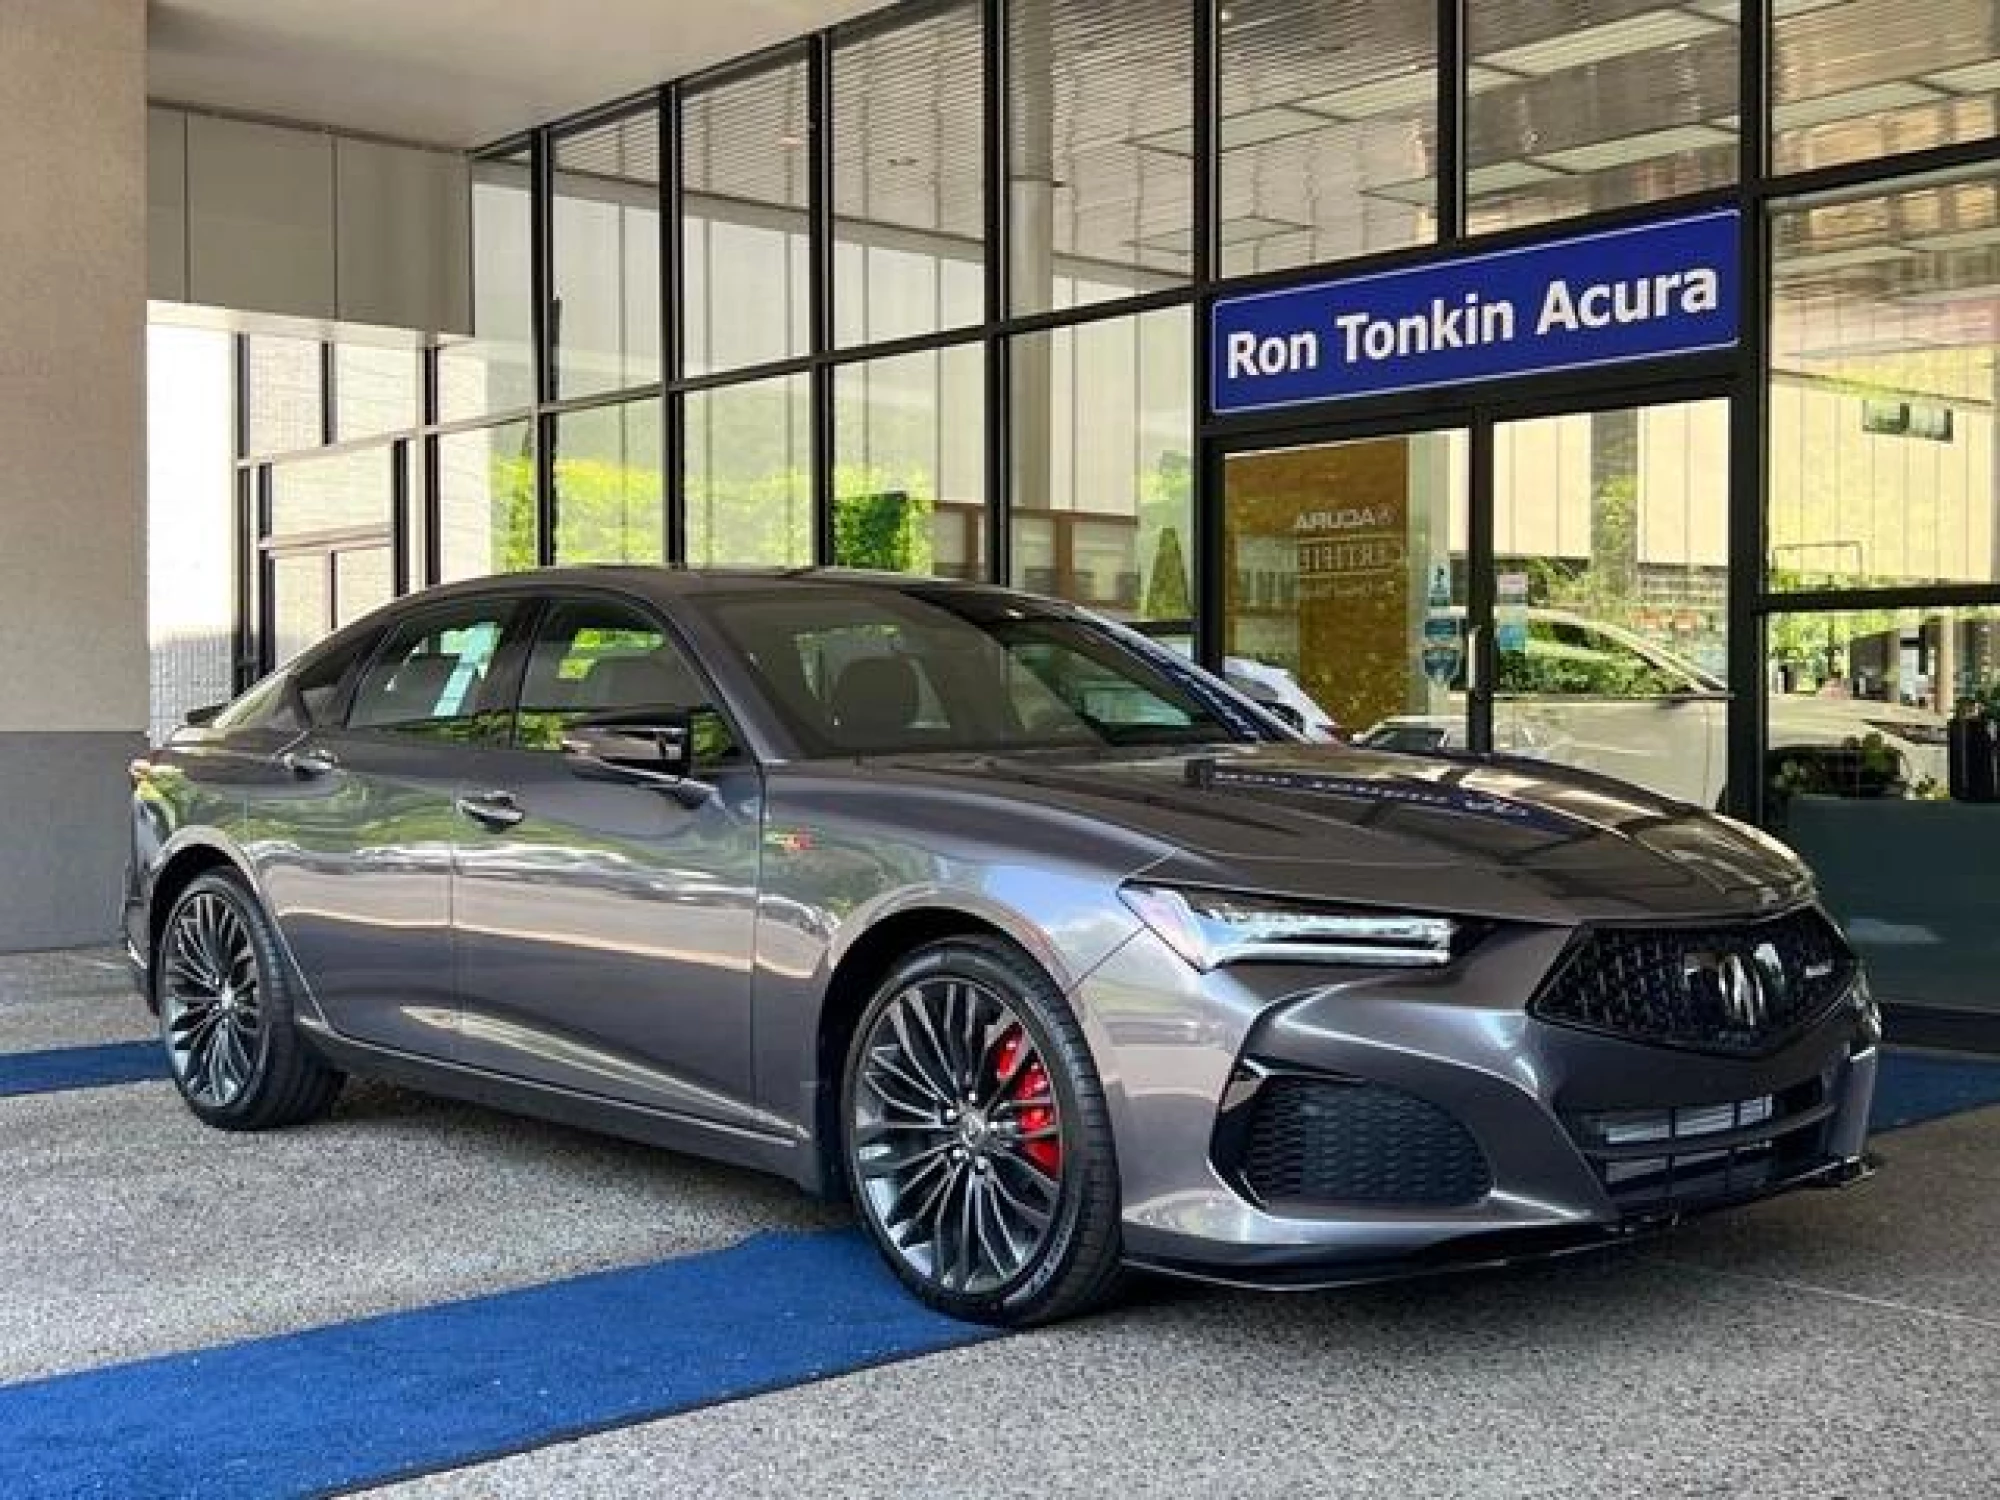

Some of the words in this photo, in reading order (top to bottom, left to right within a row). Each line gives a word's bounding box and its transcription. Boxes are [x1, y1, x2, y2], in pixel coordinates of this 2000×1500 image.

[1227, 330, 1318, 379] Ron
[1335, 294, 1515, 363] Tonkin
[1535, 267, 1718, 335] Acura
